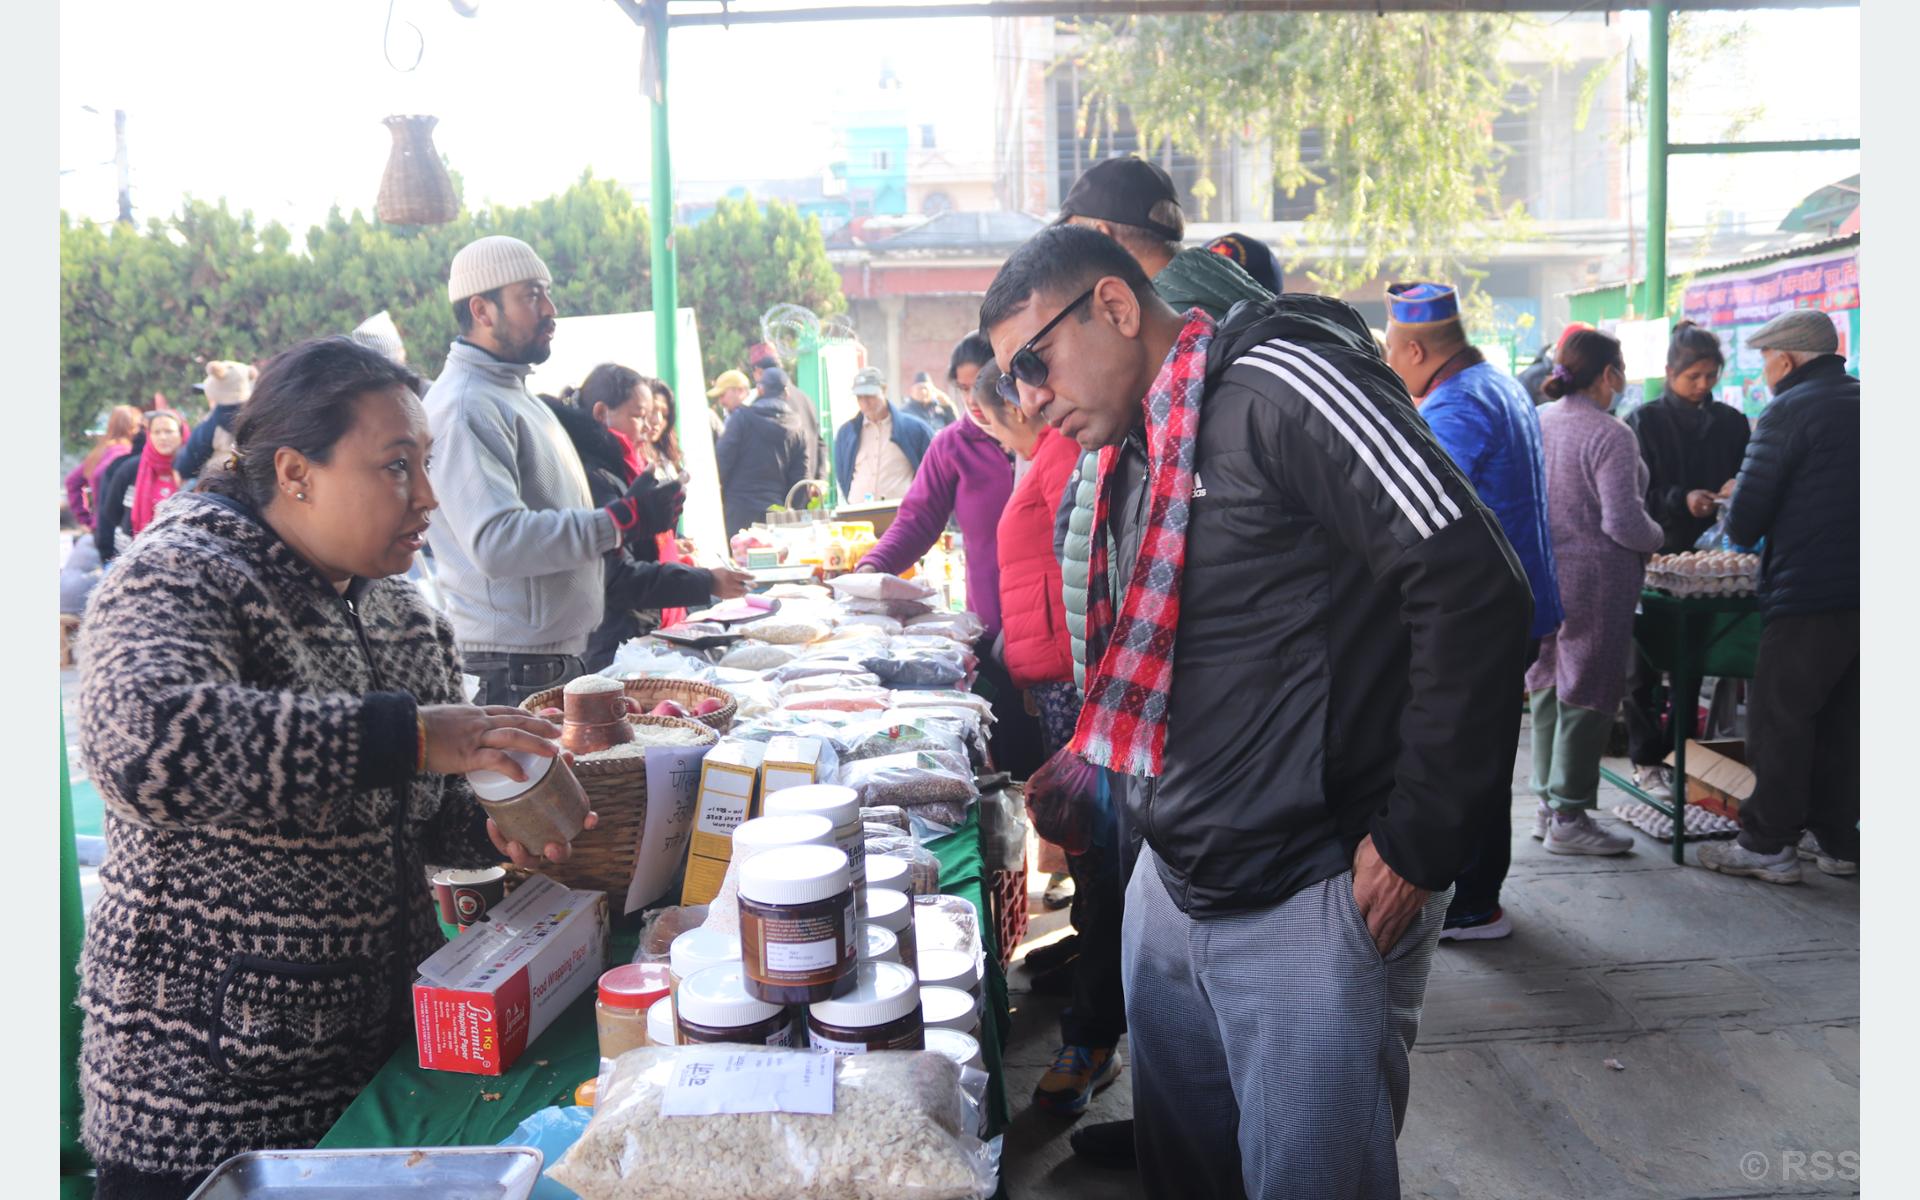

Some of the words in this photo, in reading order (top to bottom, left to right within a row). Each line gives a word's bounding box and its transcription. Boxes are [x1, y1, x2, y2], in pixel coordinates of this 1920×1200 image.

[533, 977, 547, 999] Food
[547, 957, 573, 986] Wrapping
[572, 943, 588, 963] Paper
[457, 1002, 467, 1038] Wrapping
[466, 1000, 492, 1060] Pyramid
[460, 1037, 469, 1060] Paper
[482, 1035, 493, 1050] Kg
